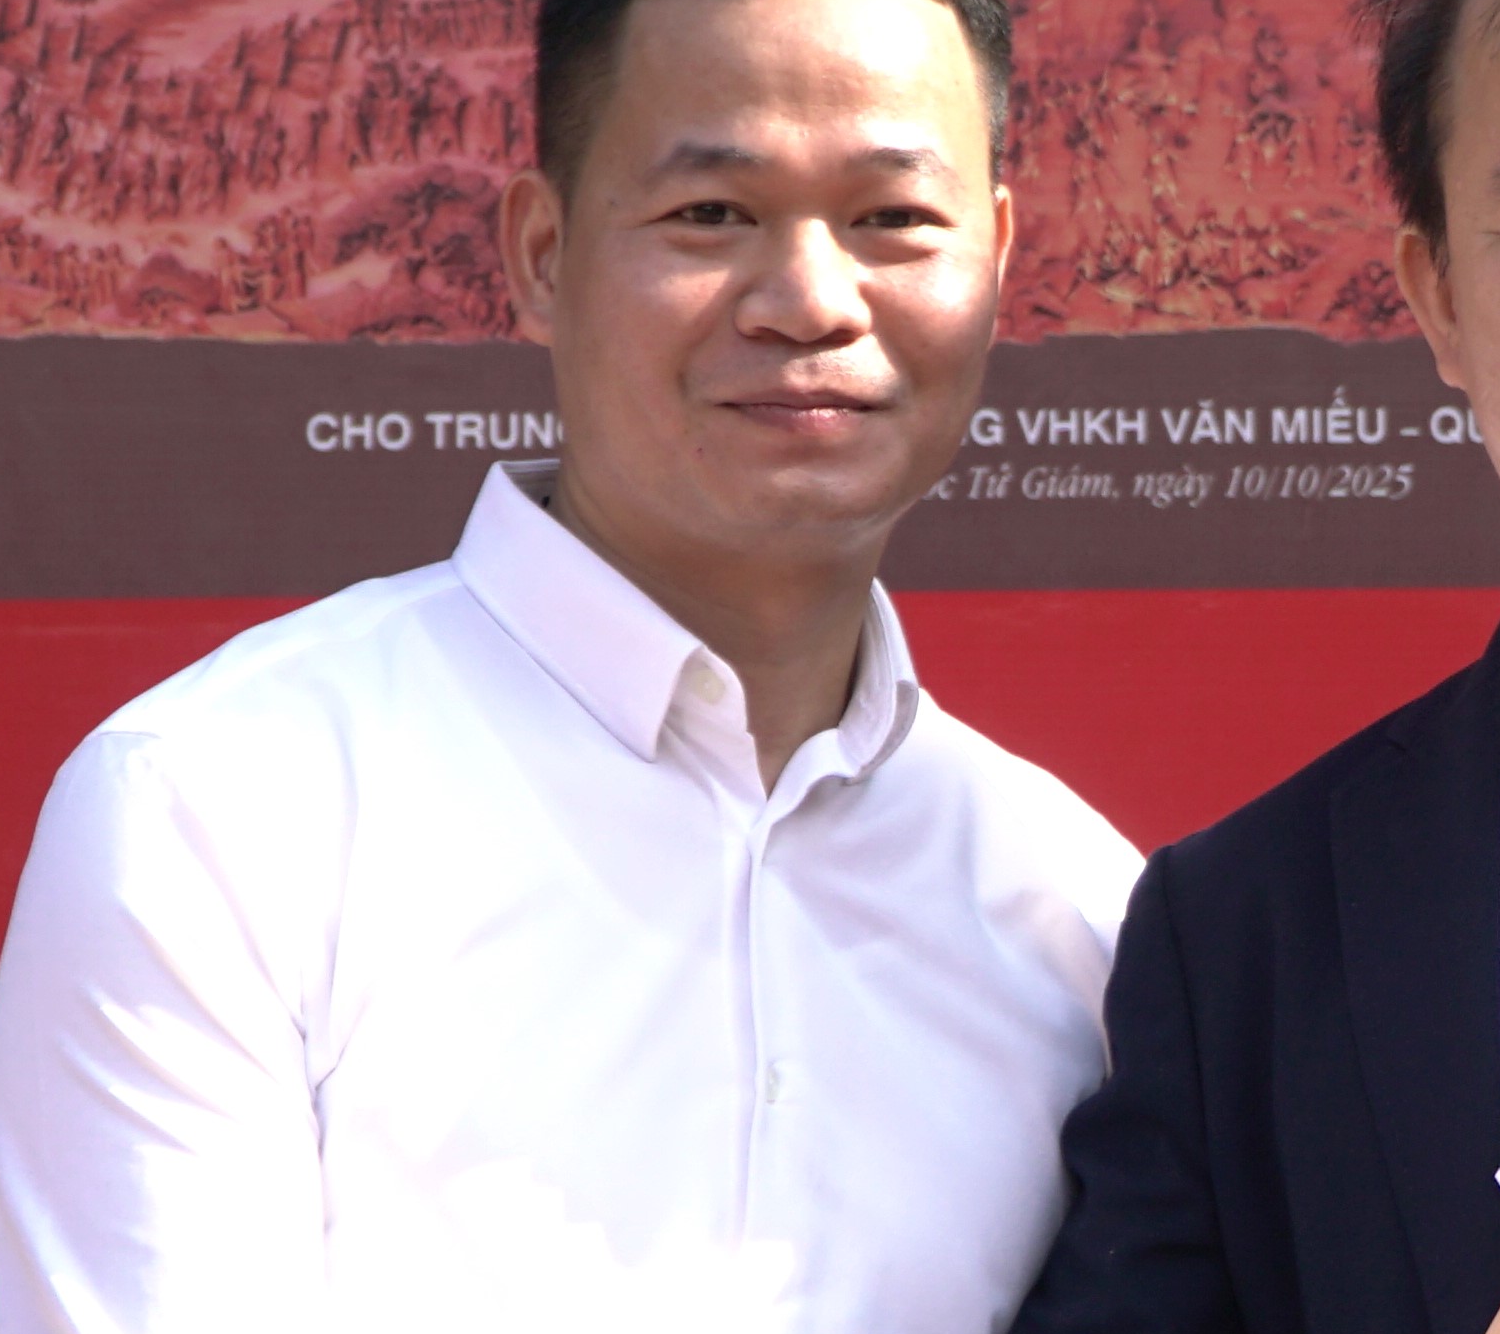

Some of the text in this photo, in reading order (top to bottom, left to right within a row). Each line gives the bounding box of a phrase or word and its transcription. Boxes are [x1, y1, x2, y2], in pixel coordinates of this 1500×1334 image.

[304, 410, 564, 453] CHO TRUN
[1015, 406, 1149, 446] VHKH
[1159, 398, 1258, 445] VĂN
[1270, 384, 1389, 445] MIẾU
[966, 461, 1014, 501] Tử
[1020, 463, 1121, 501] Giám,
[1131, 463, 1215, 510] ngày
[1223, 461, 1416, 502] 10/10/2025
